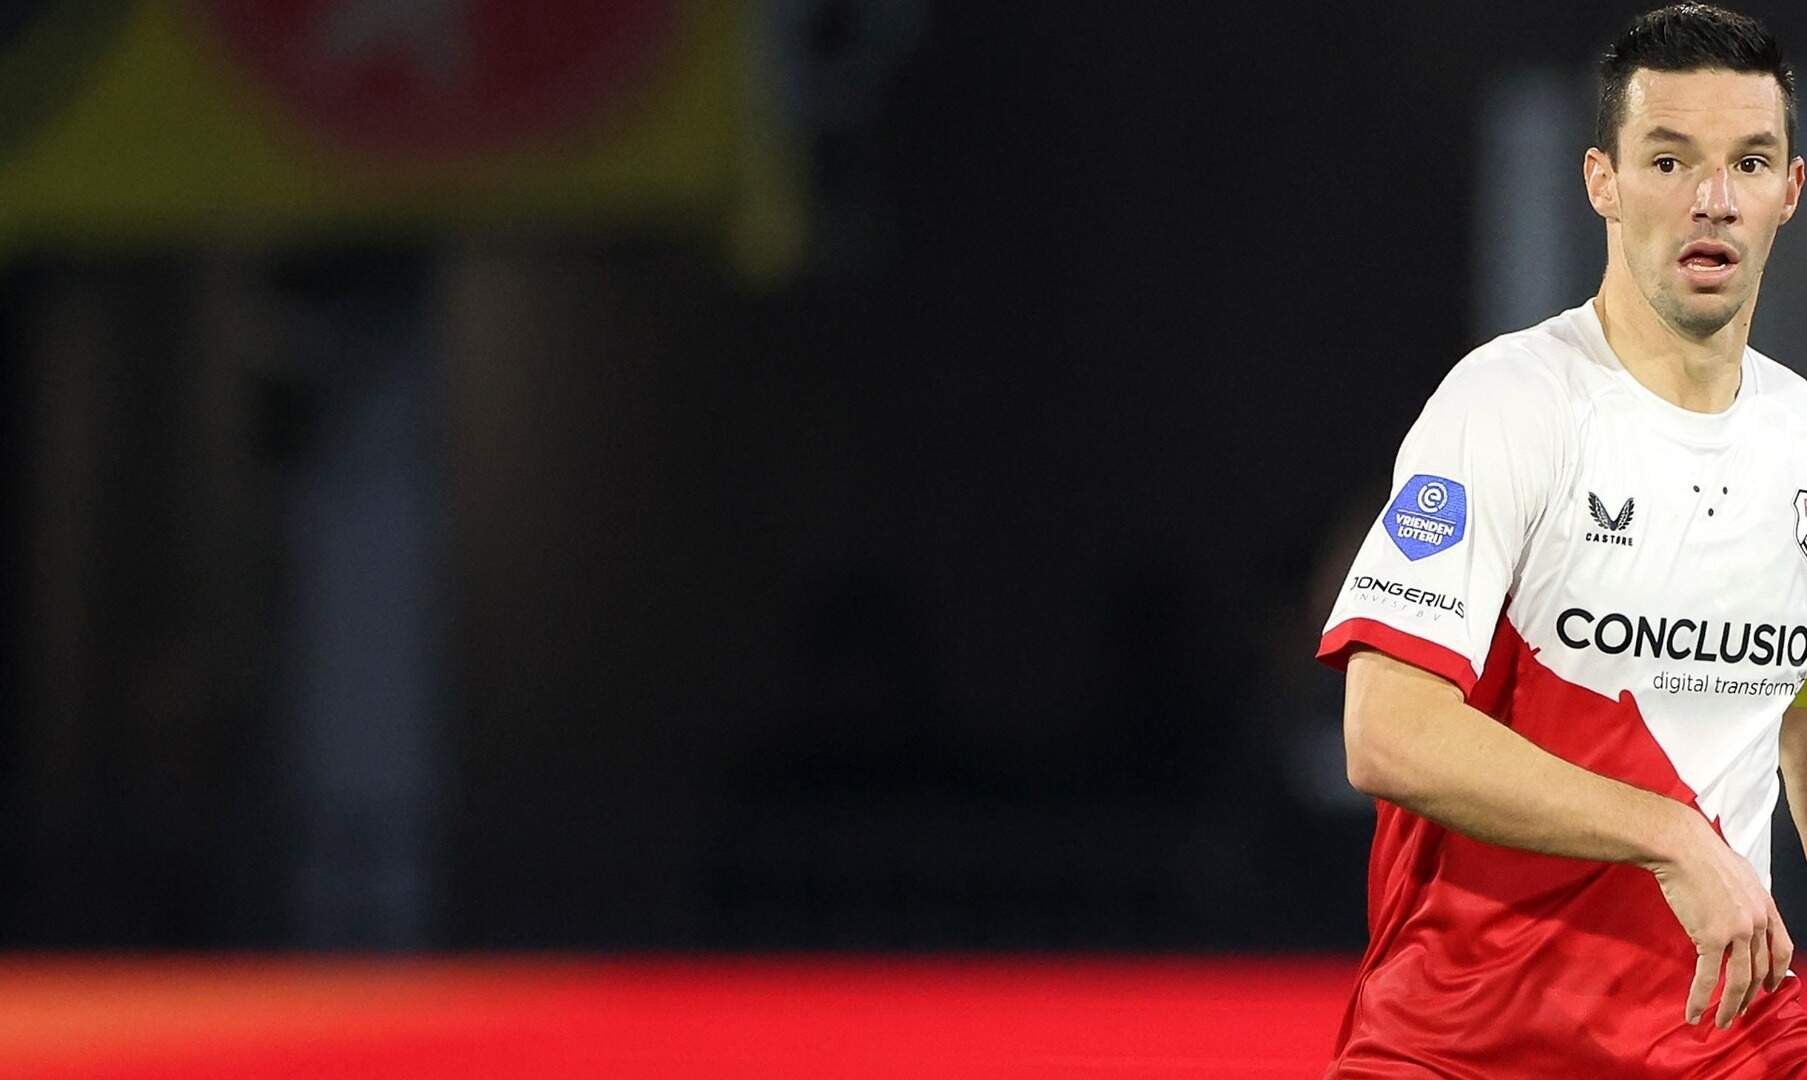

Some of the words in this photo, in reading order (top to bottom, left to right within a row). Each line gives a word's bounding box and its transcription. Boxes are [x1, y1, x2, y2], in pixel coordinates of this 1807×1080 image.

[1395, 513, 1455, 537] VRIENDEN
[1399, 527, 1443, 546] LOTERIJ
[1350, 576, 1465, 619] JONGERIUS
[1653, 671, 1709, 694] digital
